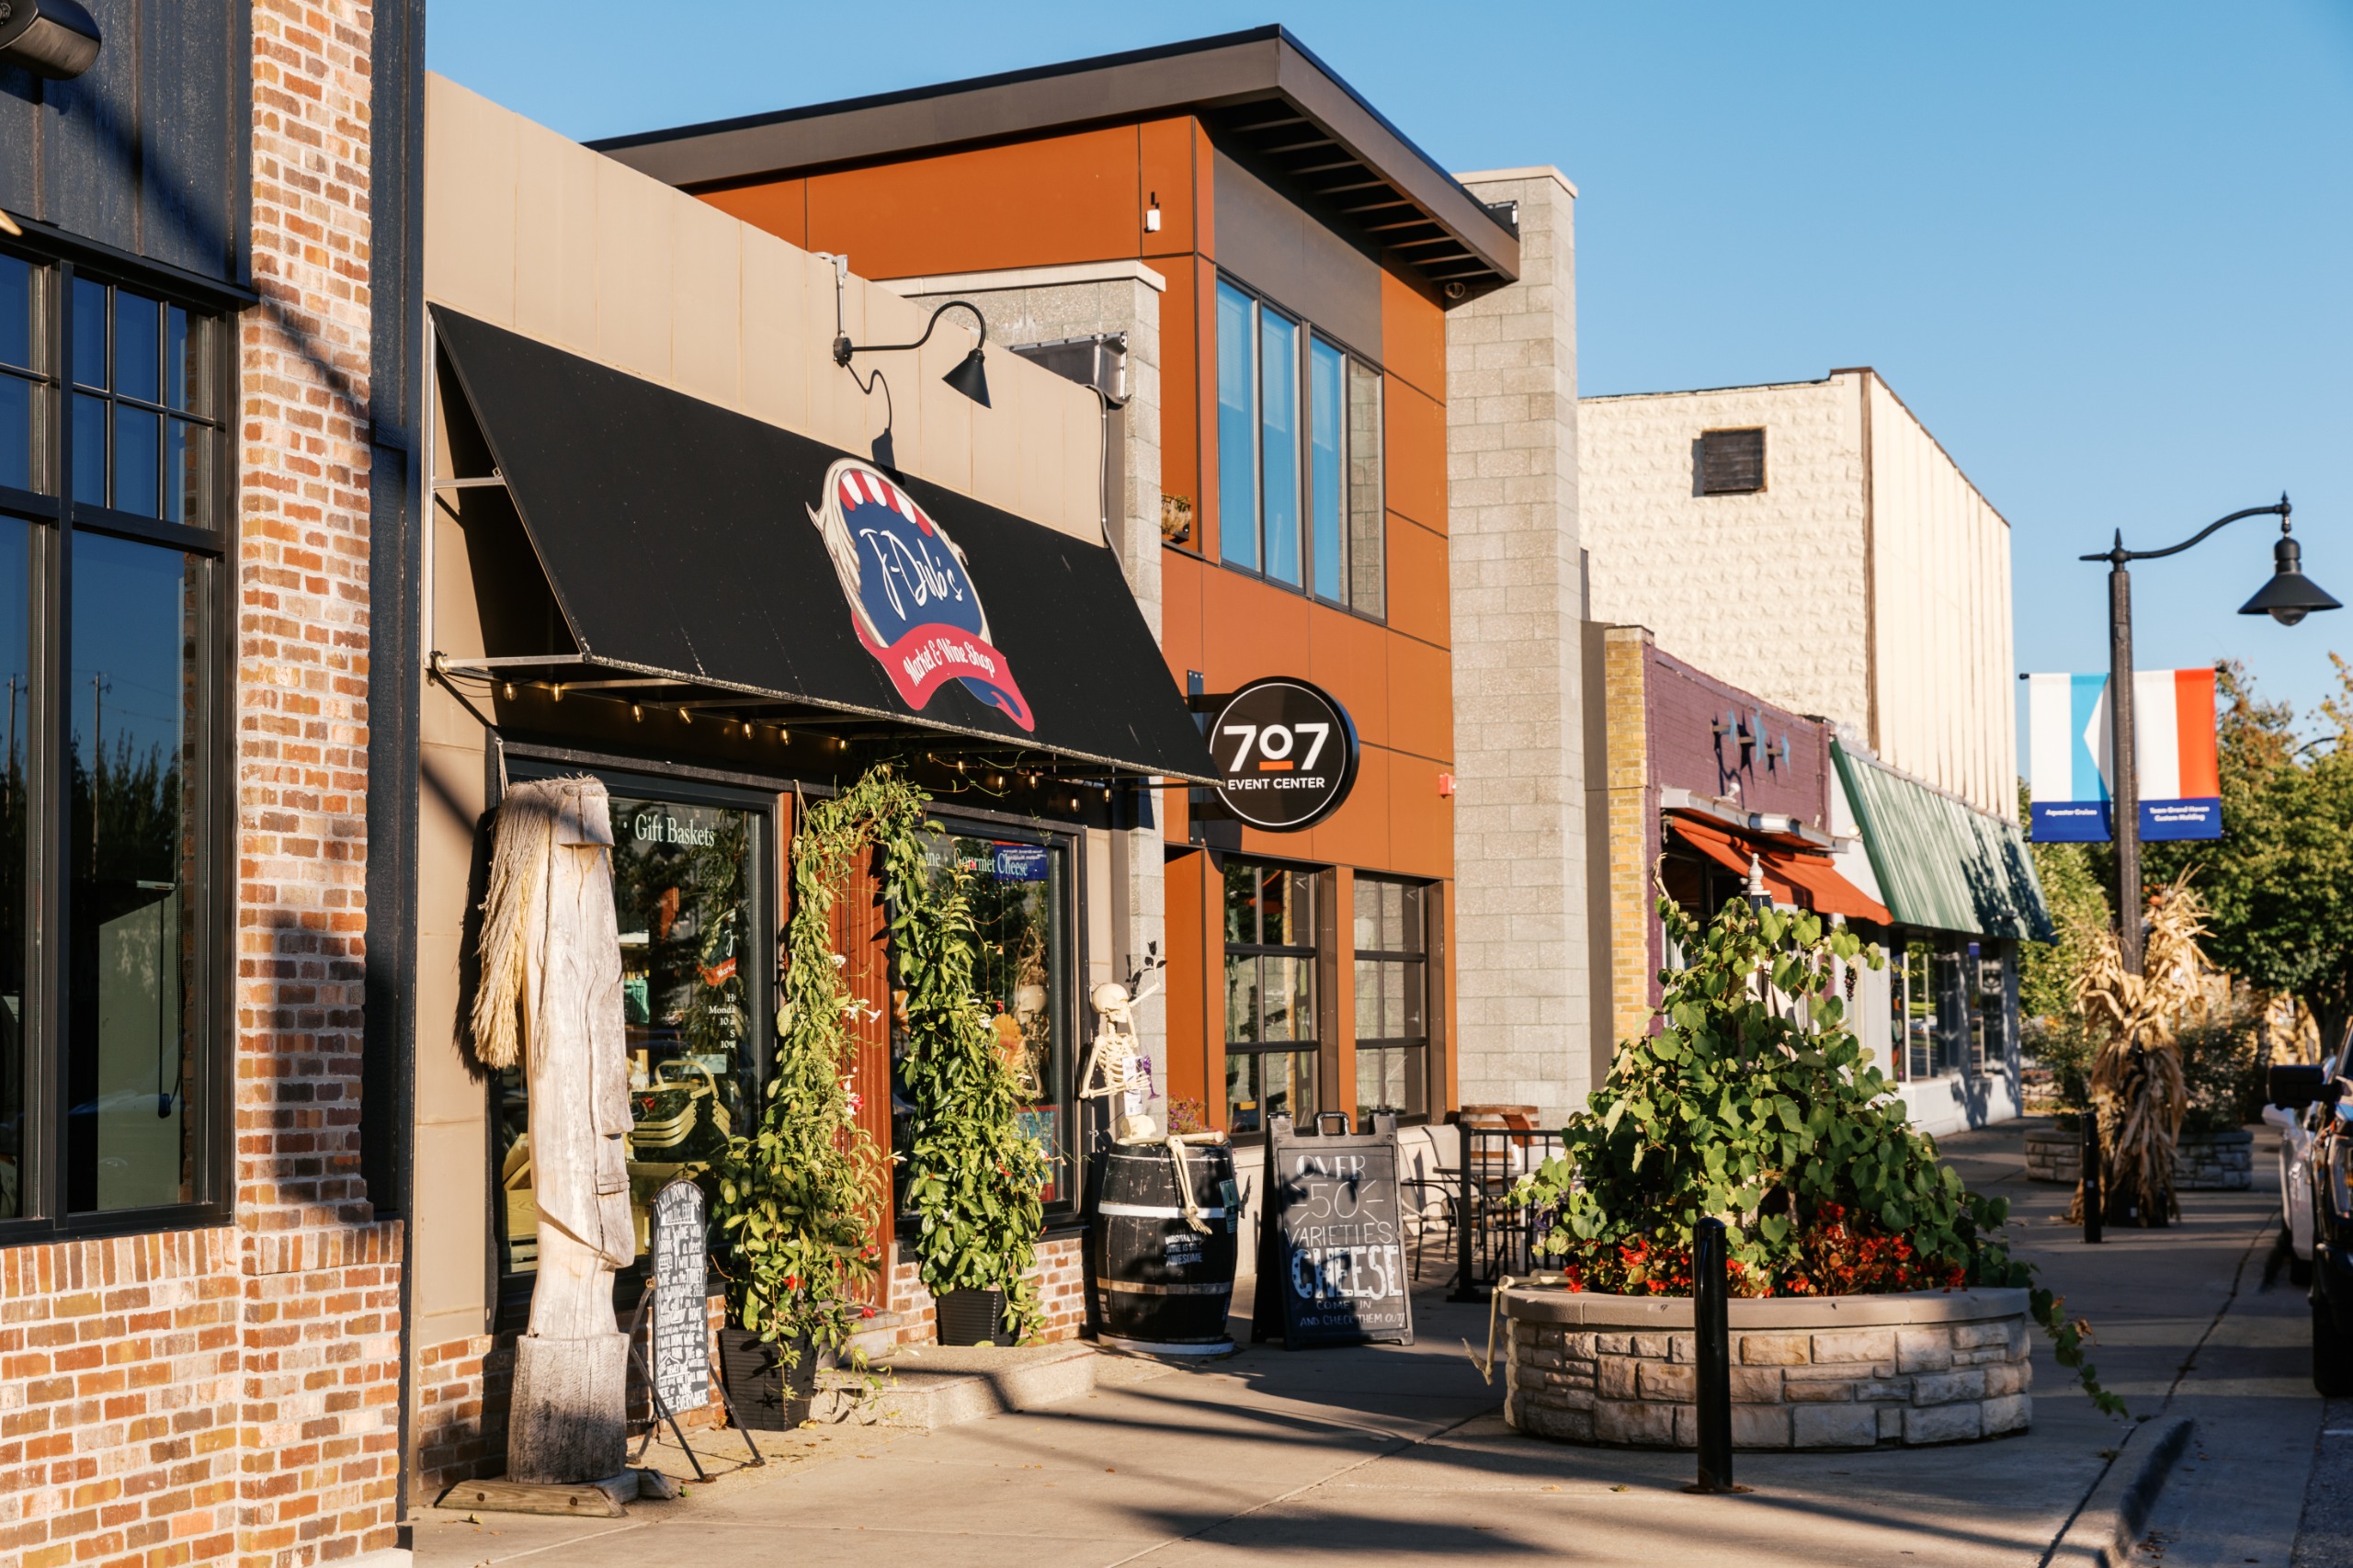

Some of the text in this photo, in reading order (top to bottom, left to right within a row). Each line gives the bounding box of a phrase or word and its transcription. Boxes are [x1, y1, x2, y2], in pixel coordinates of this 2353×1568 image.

[904, 638, 995, 687] Market & Wine Shop
[1223, 722, 1329, 772] 707
[1228, 778, 1324, 790] EVENT CENTER
[634, 813, 715, 846] Gift Baskets
[923, 846, 1028, 877] ine Gourmet Cheese
[709, 1005, 735, 1014] Monda
[1296, 1154, 1366, 1180] OVER
[1310, 1181, 1358, 1219] 50
[1284, 1221, 1392, 1248] VARIETIES
[1166, 1253, 1203, 1266] AWESOME
[1183, 1244, 1188, 1252] IS
[1291, 1244, 1404, 1301] CHEESE
[1316, 1301, 1371, 1310] COME IN
[1300, 1312, 1405, 1327] AND CHECK THEM OUT!
